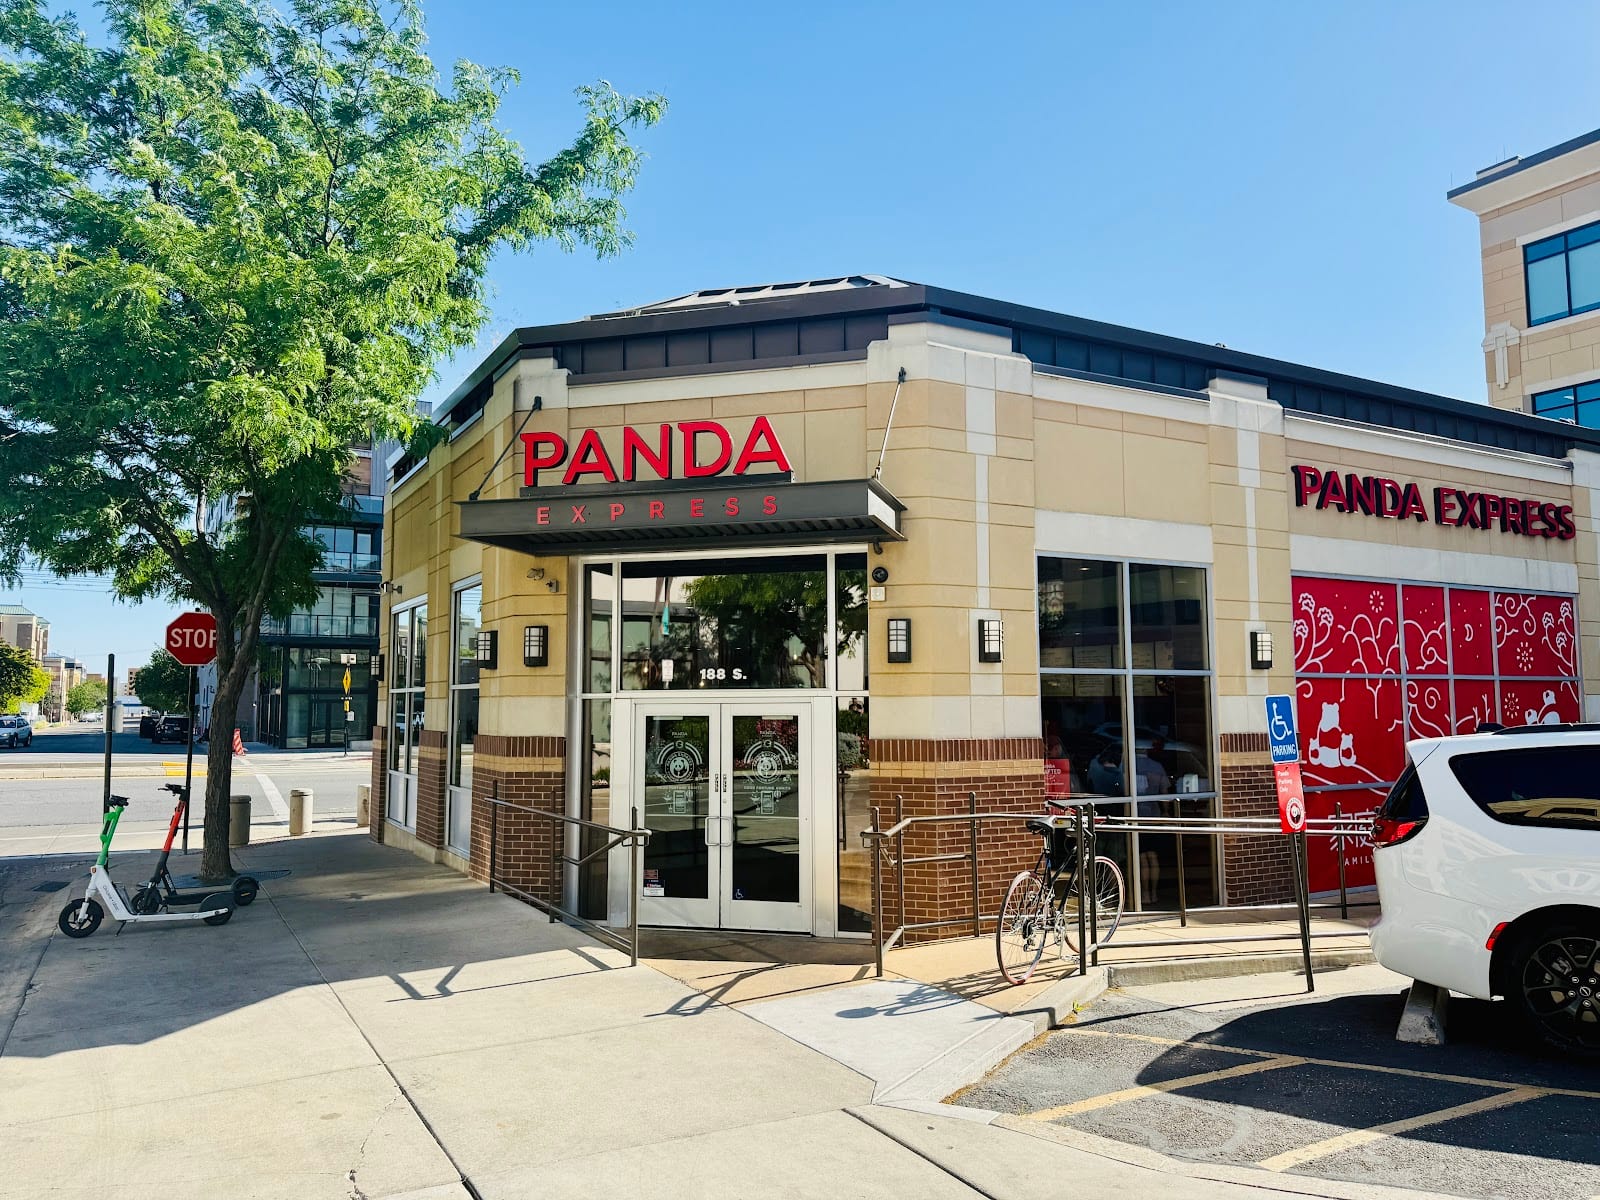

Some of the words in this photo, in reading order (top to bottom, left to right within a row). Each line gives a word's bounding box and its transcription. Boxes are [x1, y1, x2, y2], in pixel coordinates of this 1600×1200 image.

[520, 416, 791, 487] PANDA
[536, 494, 778, 526] EXPRESS
[1291, 465, 1428, 523] PANDA
[1434, 487, 1577, 541] EXPRESS
[699, 668, 726, 680] 188
[732, 668, 748, 680] S.
[1273, 743, 1296, 756] PARKING
